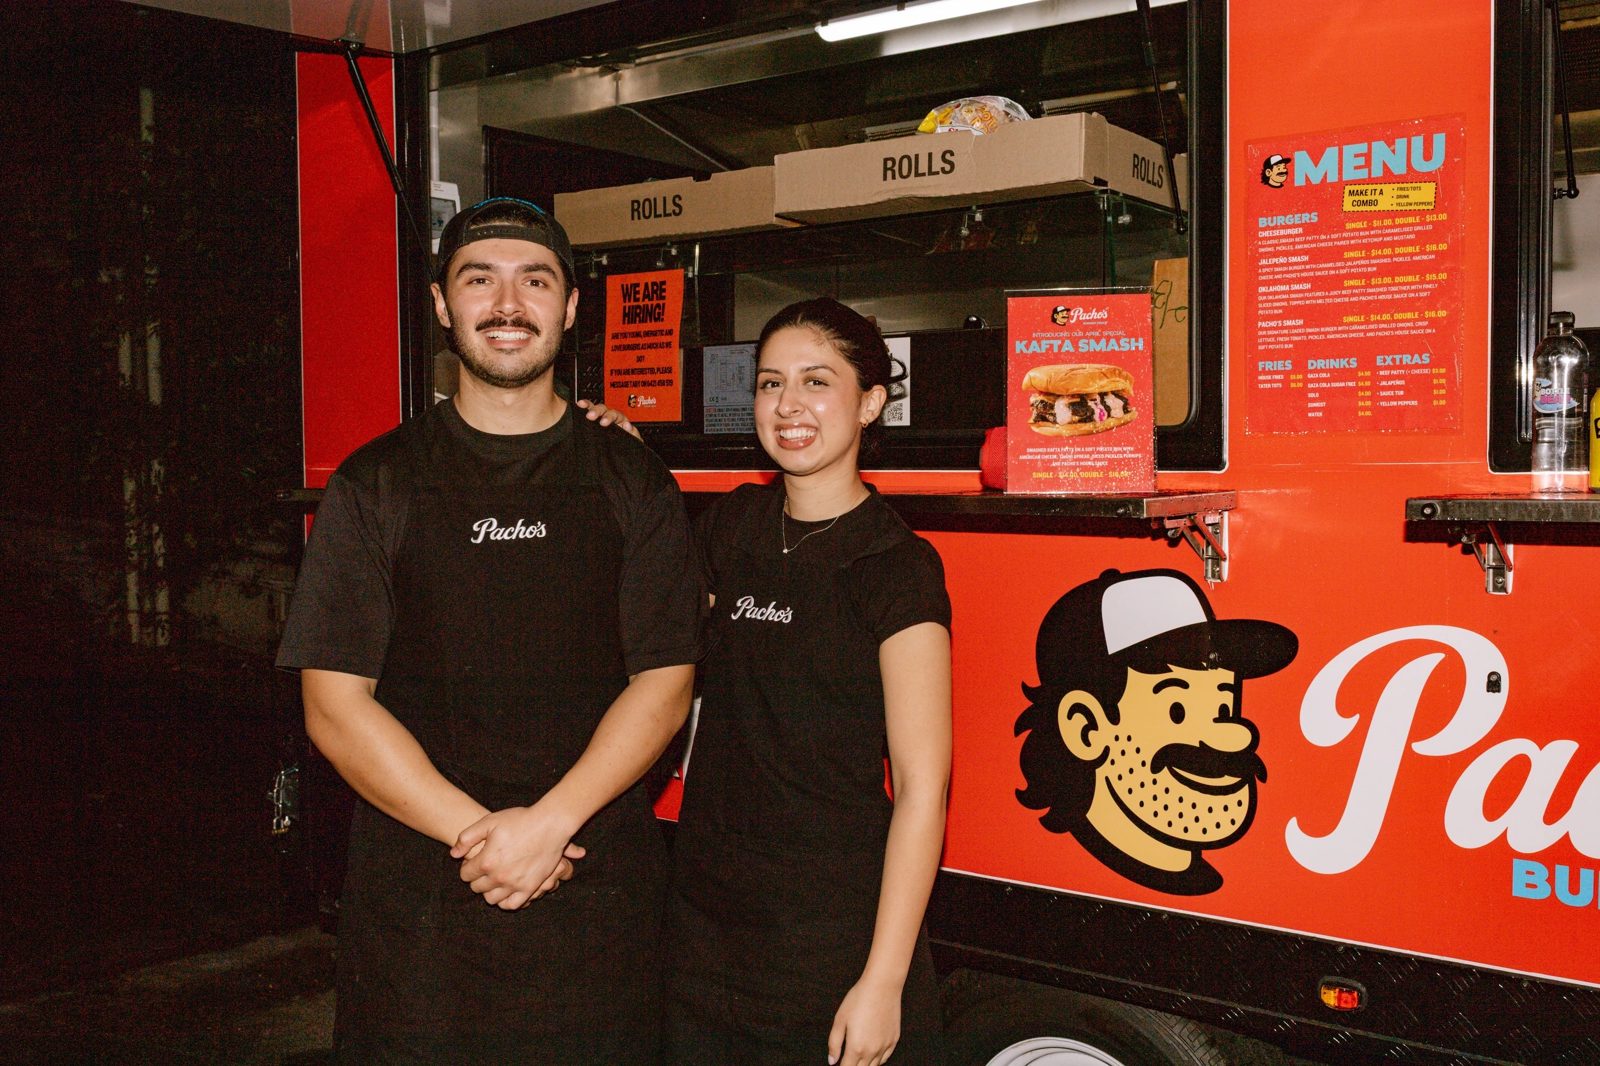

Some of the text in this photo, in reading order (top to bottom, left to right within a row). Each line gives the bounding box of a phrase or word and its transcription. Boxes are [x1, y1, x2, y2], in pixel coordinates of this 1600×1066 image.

[882, 149, 955, 182] ROLLS
[1294, 133, 1446, 186] MENU
[1132, 153, 1164, 189] ROLLS
[631, 195, 683, 220] ROLLS
[1352, 199, 1378, 207] COMBO
[1259, 212, 1318, 227] BURGERS
[1345, 221, 1367, 230] SINGLE
[1395, 216, 1420, 225] DOUBLE
[1259, 228, 1303, 237] CHEESEBURGER
[1288, 255, 1309, 263] SMASH
[1344, 250, 1365, 258] SINGLE
[1395, 246, 1420, 254] DOUBLE
[1395, 275, 1420, 283] DOUBLE
[621, 281, 667, 303] WE ARE
[622, 303, 665, 325] HIRING!
[1070, 308, 1108, 323] Pacho's
[1343, 315, 1364, 323] SINGLE
[1394, 312, 1419, 320] DOUBLE
[1016, 338, 1143, 353] KAFTA SMASH
[1258, 360, 1292, 371] FRIES
[1308, 358, 1357, 369] DRINKS
[1376, 353, 1430, 366] EXTRAS
[471, 518, 546, 543] Pacho's
[731, 596, 793, 623] Pacho's
[1512, 858, 1600, 910] BU
